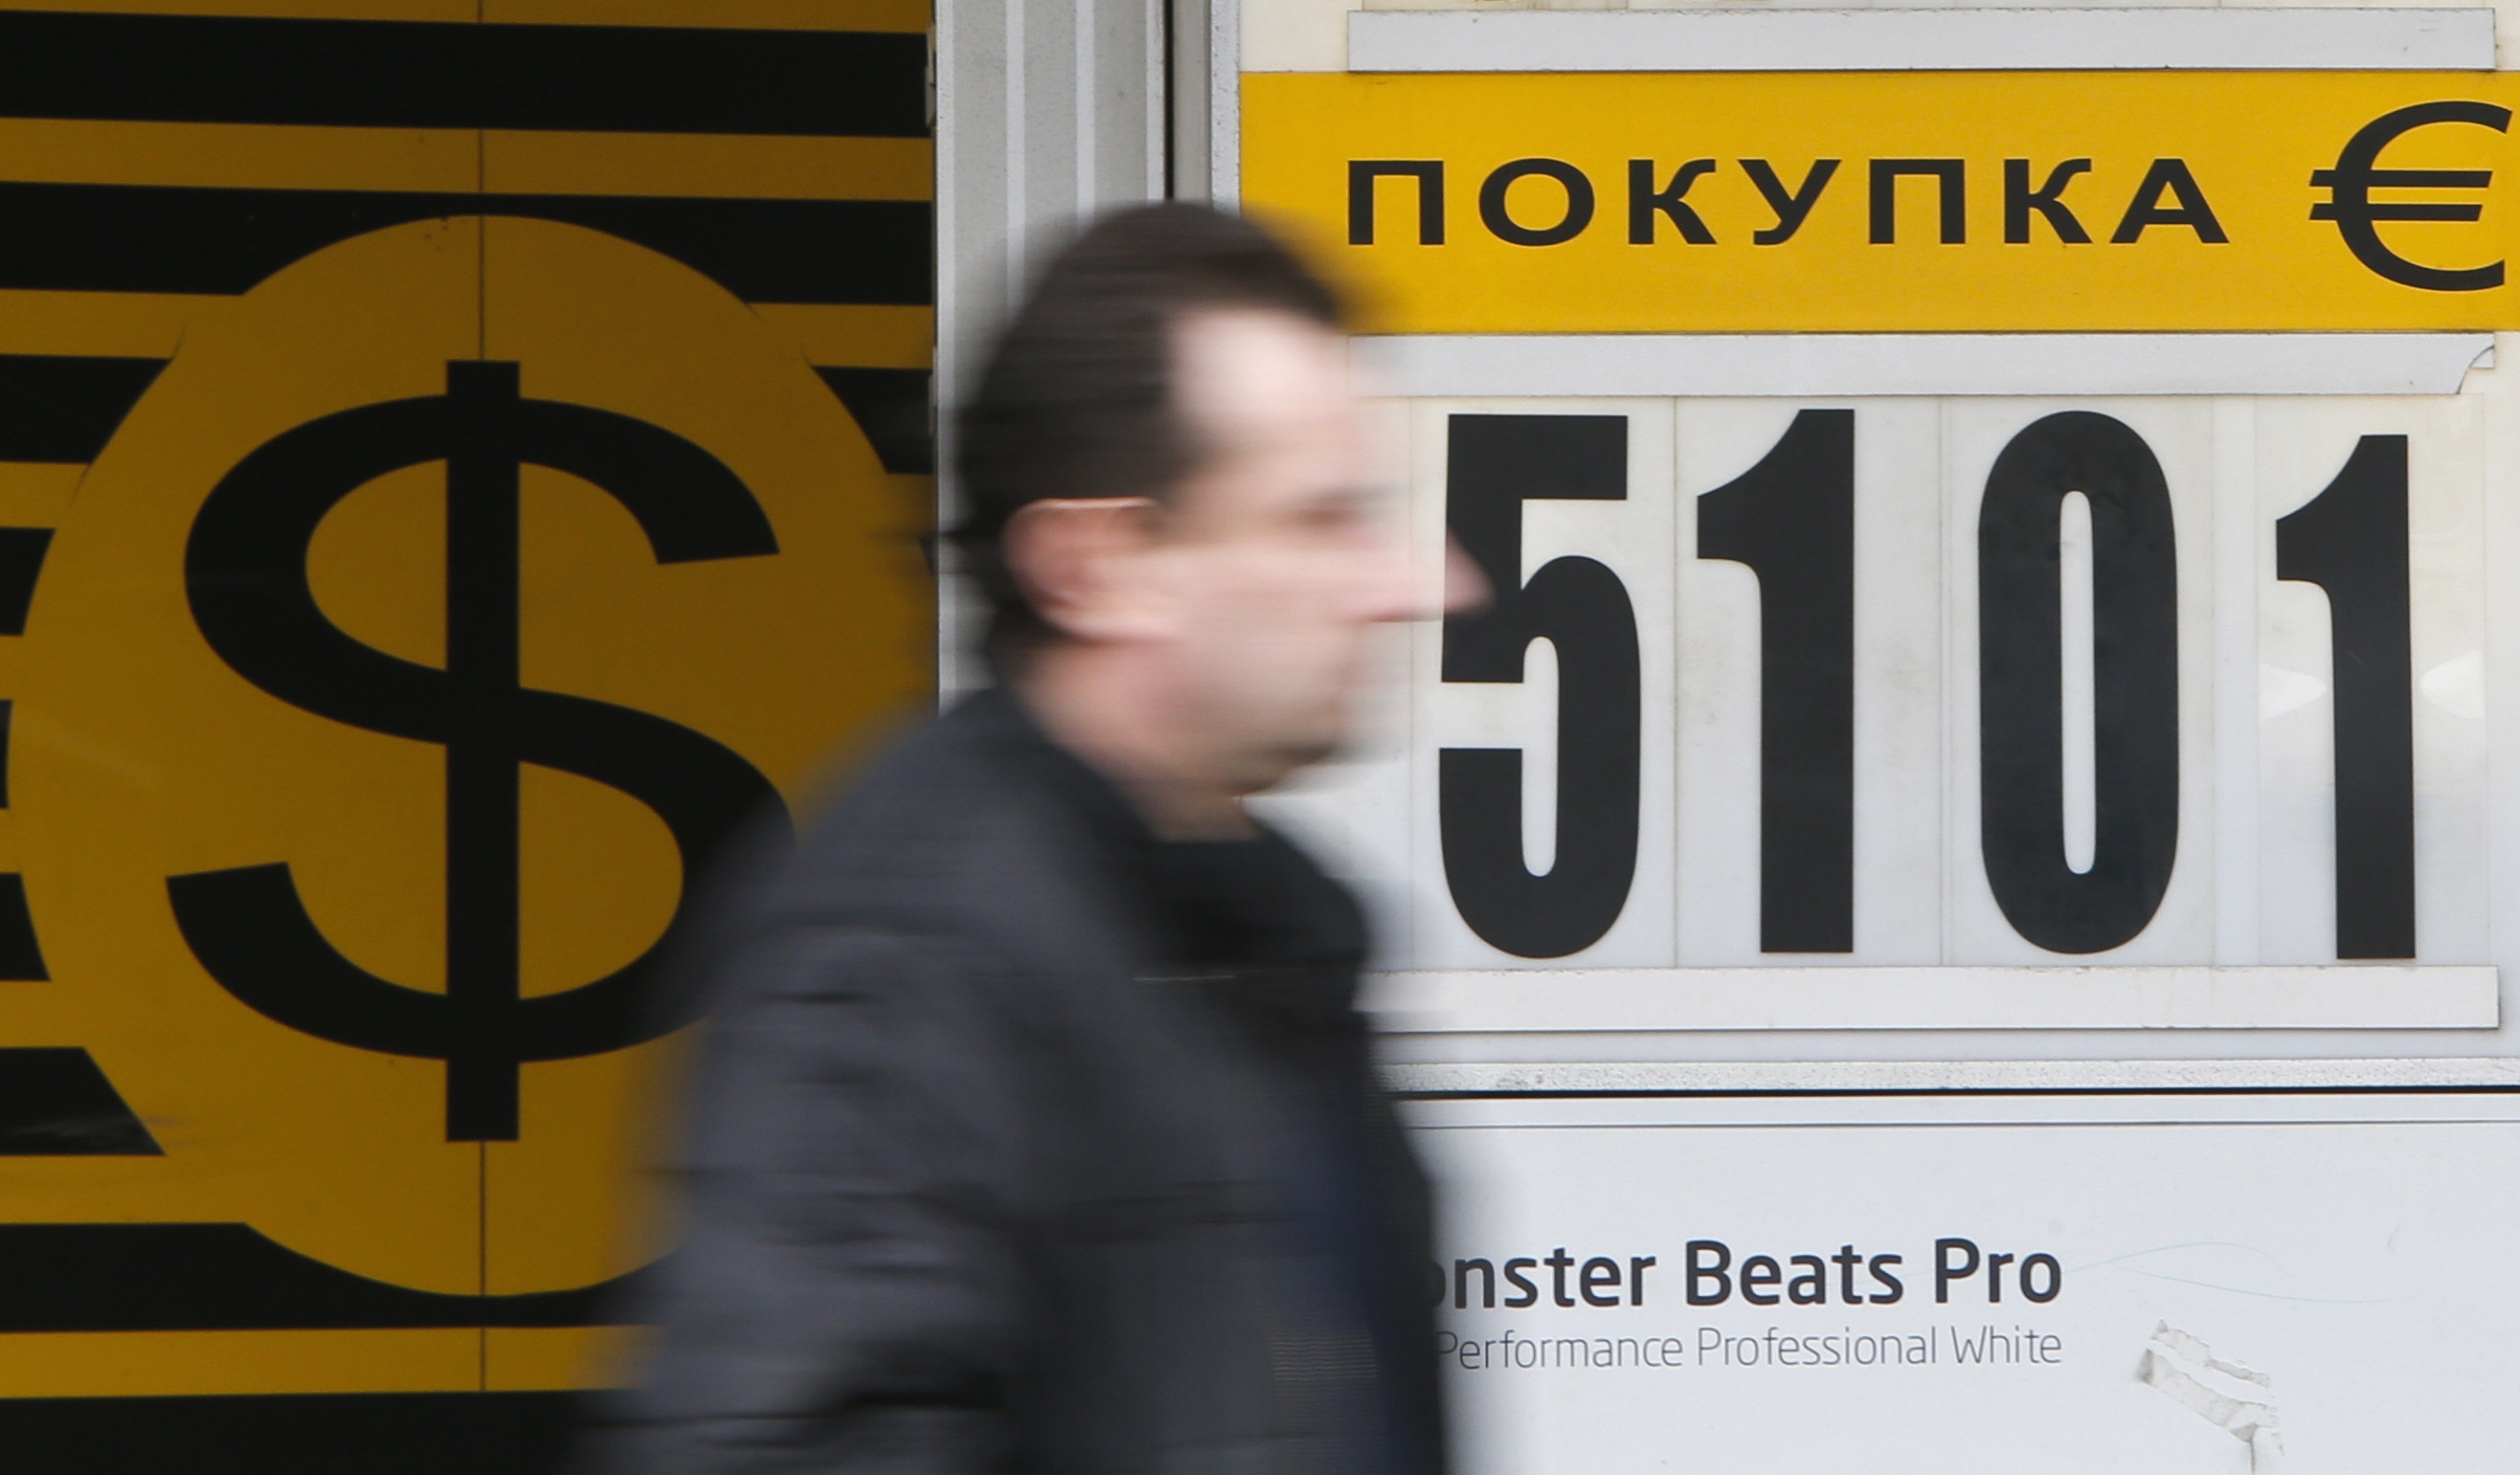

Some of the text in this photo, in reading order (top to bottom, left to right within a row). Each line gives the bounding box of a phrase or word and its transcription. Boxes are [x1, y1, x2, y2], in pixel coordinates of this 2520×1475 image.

[1348, 101, 2513, 291] ПОКУПКА €
[166, 361, 796, 1143] $
[1686, 1240, 1903, 1306] Beats
[1934, 1238, 2061, 1304] Pro
[1698, 1326, 1936, 1366] Professional
[1950, 1325, 2062, 1364] White
